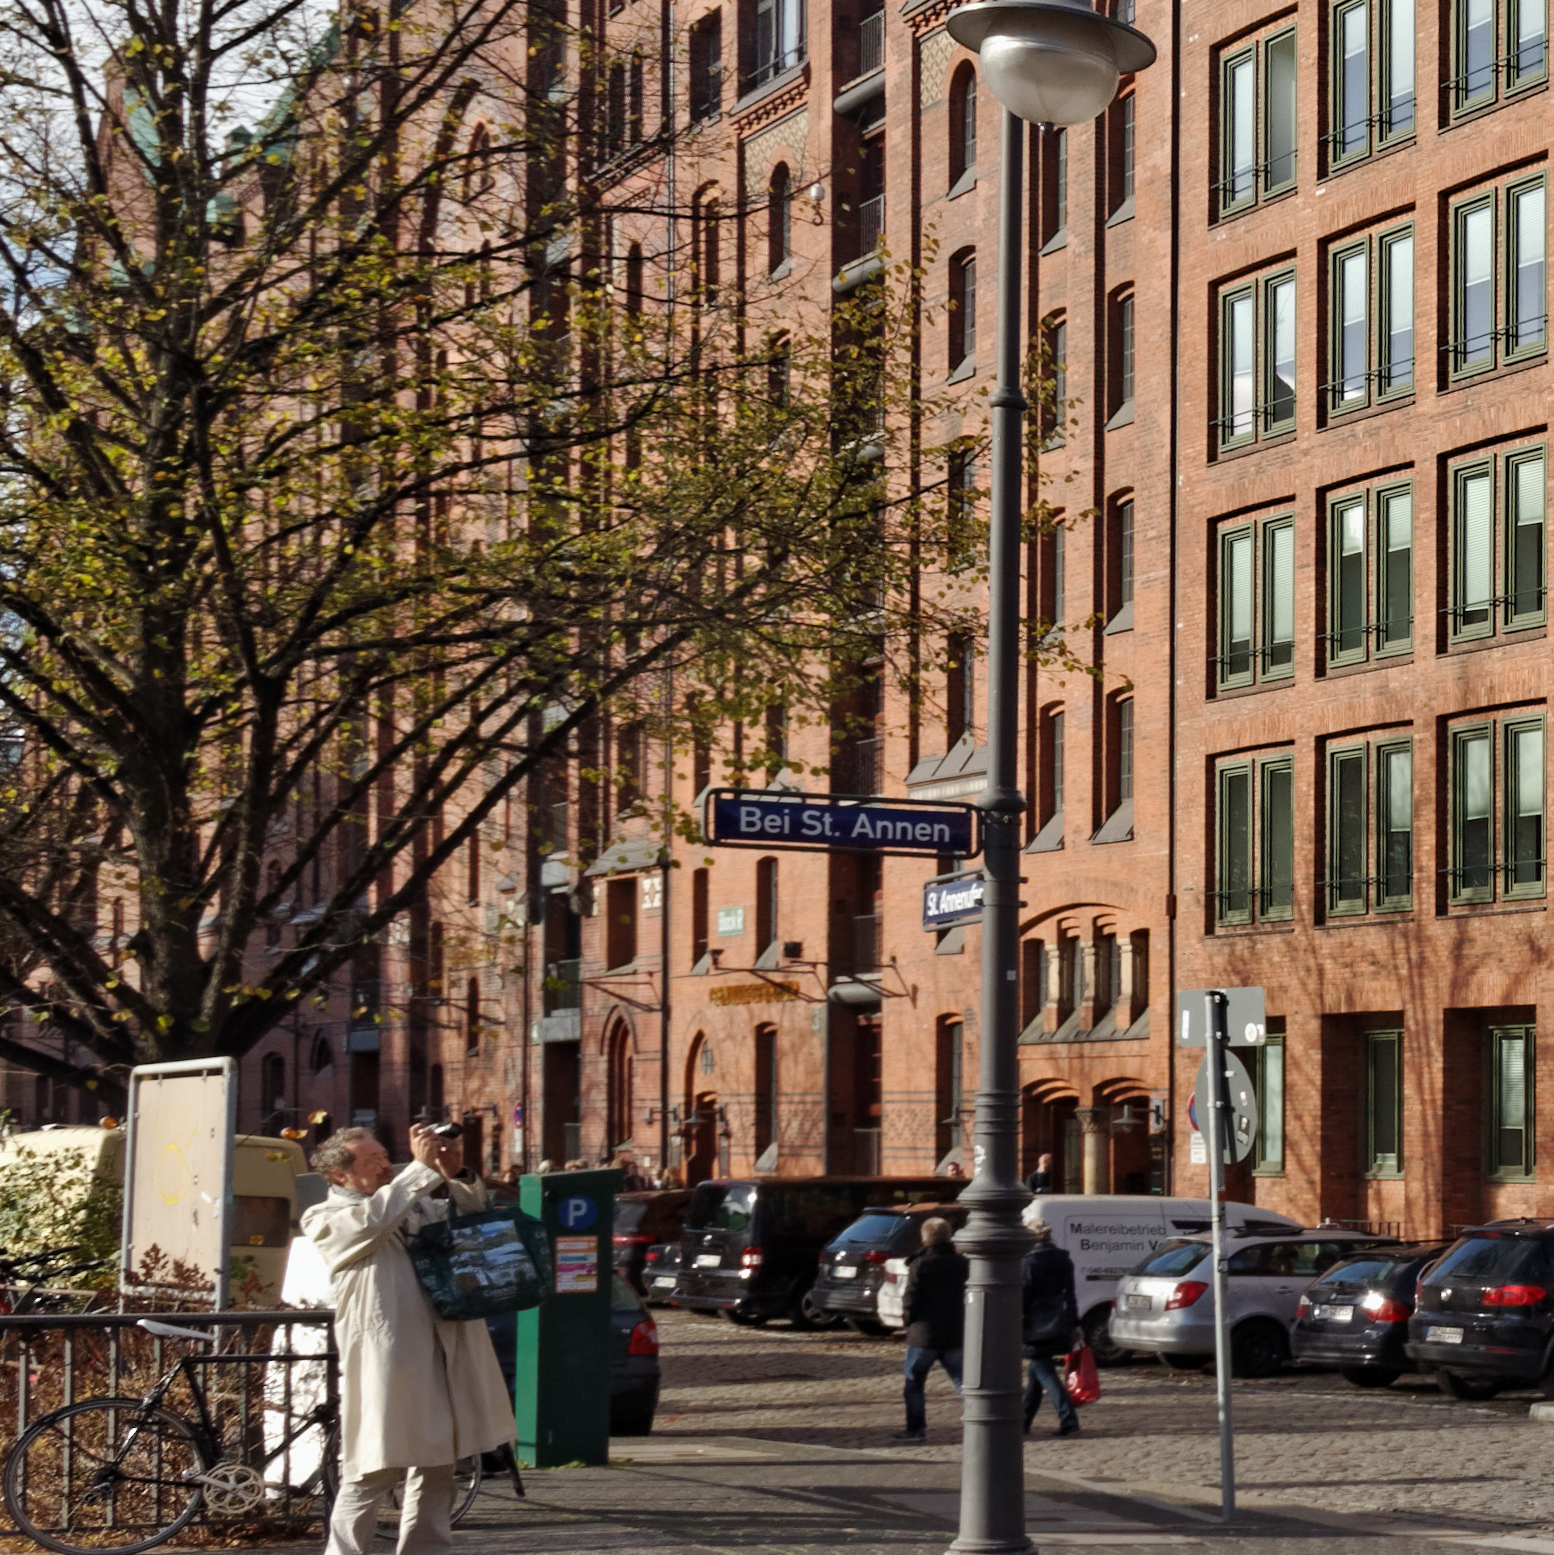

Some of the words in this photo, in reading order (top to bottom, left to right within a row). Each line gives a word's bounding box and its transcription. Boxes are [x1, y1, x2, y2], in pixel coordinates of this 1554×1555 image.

[739, 806, 791, 835] Bei
[801, 810, 840, 837] St.
[850, 813, 950, 843] Annen
[567, 1198, 588, 1227] P
[1070, 1223, 1166, 1235] Malereibetrieb
[1081, 1239, 1144, 1253] Benjamin
